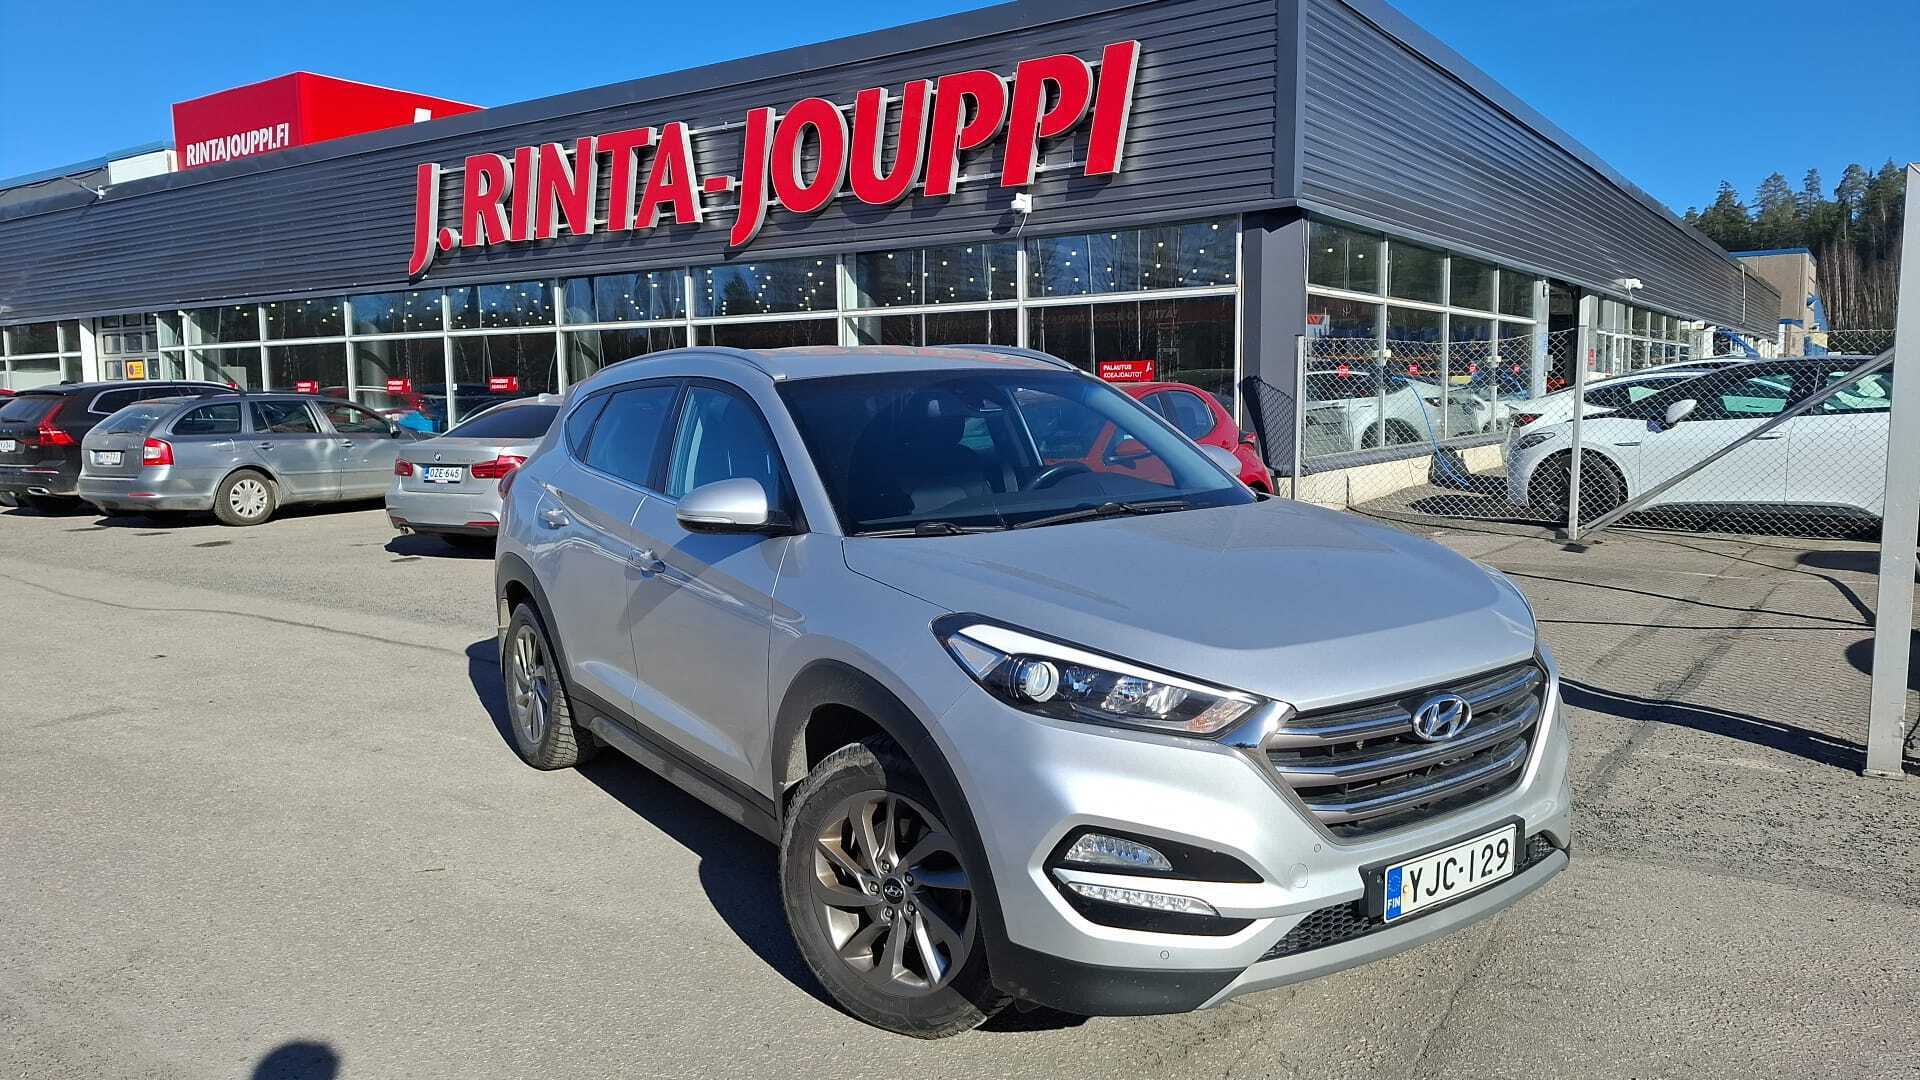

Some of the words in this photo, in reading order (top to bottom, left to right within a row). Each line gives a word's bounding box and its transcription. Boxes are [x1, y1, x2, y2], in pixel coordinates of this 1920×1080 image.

[186, 123, 289, 166] RINTAJOUPPI.FI
[1103, 371, 1143, 379] KOEAJOAUTOT
[1409, 837, 1509, 903] YJC-129
[1387, 895, 1401, 909] FIN
